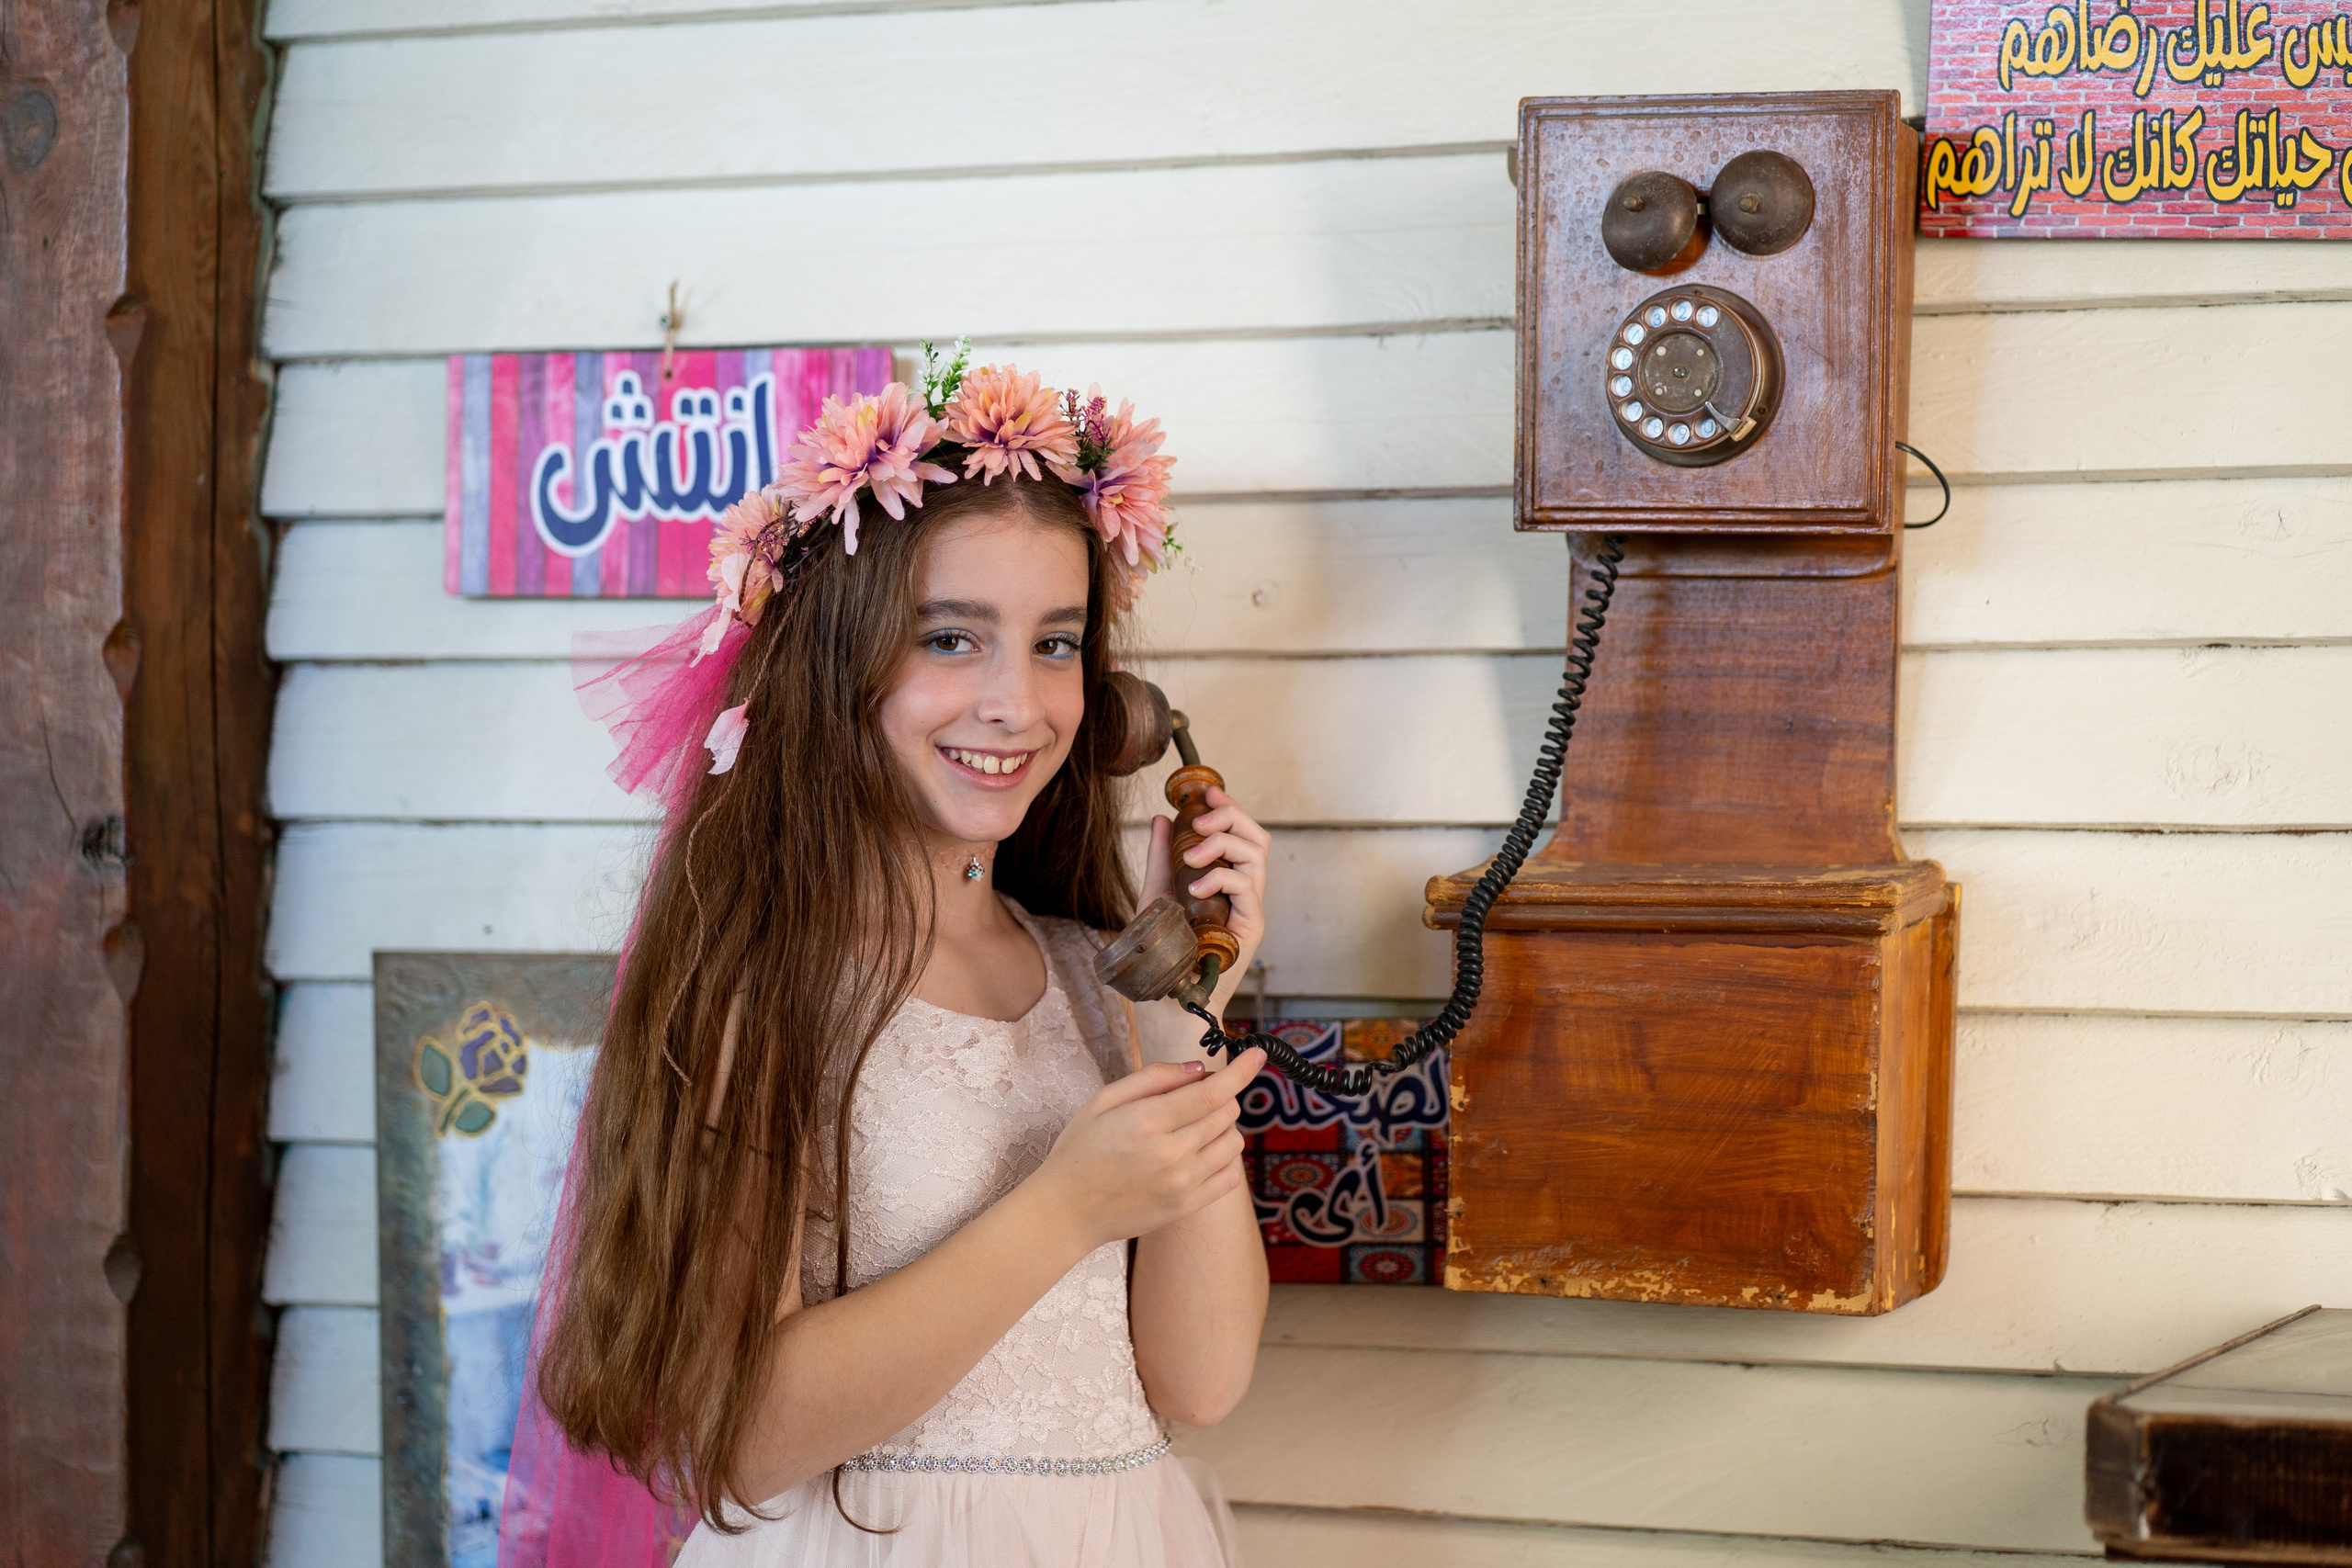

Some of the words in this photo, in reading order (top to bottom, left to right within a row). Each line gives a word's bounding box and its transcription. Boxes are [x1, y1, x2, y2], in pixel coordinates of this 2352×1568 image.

[1997, 0, 2159, 98] رضاهم
[2165, 0, 2274, 88] عليك
[1925, 109, 2054, 219] تراهم
[2058, 108, 2096, 197] لا
[2101, 105, 2205, 204] كانك
[2207, 107, 2335, 209] حياتك
[530, 370, 777, 557] انتش
